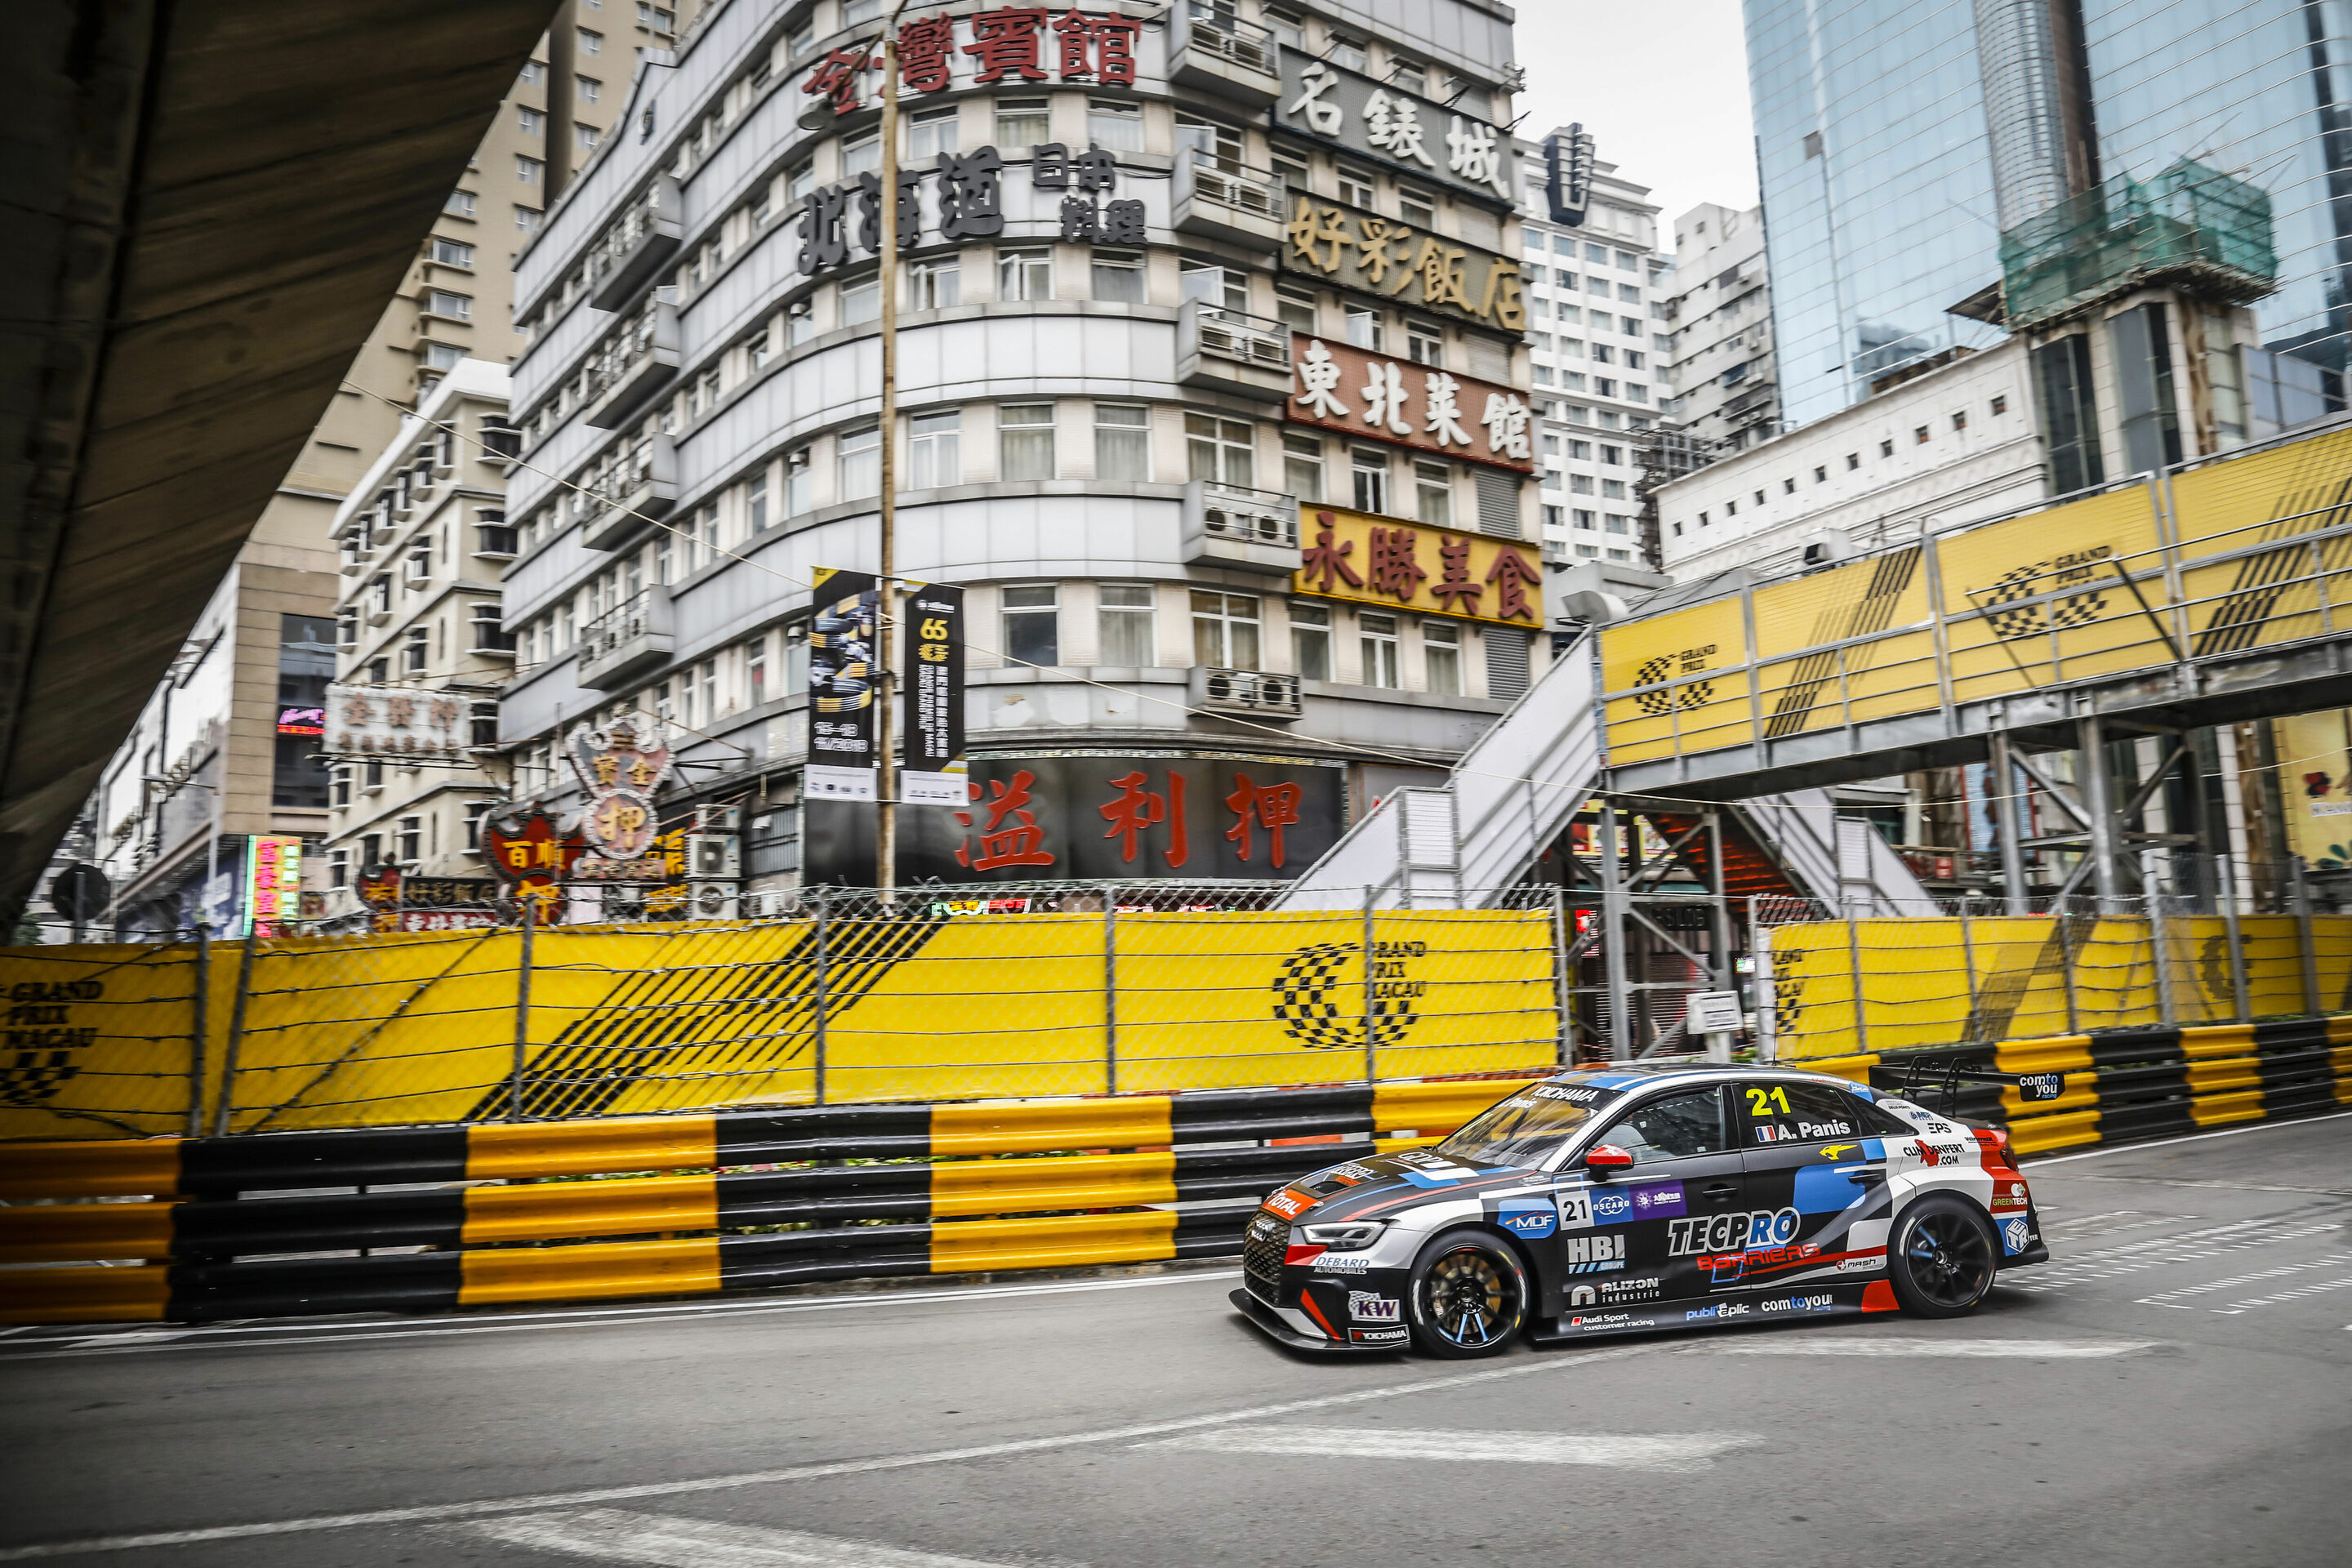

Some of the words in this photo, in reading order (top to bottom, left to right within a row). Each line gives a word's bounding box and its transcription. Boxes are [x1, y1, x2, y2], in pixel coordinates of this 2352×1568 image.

[1032, 142, 1116, 193] 日本
[1061, 194, 1147, 245] 料理
[1289, 197, 1527, 332] 好彩飯店
[1297, 340, 1532, 460] 東北菜館
[1303, 510, 1542, 619] 永勝美食
[920, 618, 948, 641] 65
[953, 769, 1303, 872] 溢利押
[1369, 941, 1427, 958] RAND
[1365, 961, 1406, 978] RIX
[1530, 1085, 1601, 1102] YOKOHAMA
[2036, 1084, 2058, 1098] you
[1745, 1086, 1792, 1117] 21
[1778, 1124, 1797, 1141] A.
[1798, 1119, 1851, 1138] Panis
[1927, 1122, 1952, 1134] EPS
[1268, 1191, 1302, 1215] TOTAL
[1593, 1200, 1630, 1211] OSCARO
[1993, 1197, 2028, 1206] GREENTECH
[1563, 1199, 1588, 1223] 21
[1517, 1214, 1555, 1229] MDF
[1668, 1206, 1802, 1257] TECPRO
[1567, 1234, 1626, 1263] HBI
[1316, 1256, 1370, 1267] DEBARD
[1602, 1290, 1660, 1303] industrie
[1358, 1300, 1397, 1316] KW
[1582, 1315, 1602, 1324] Audi
[1604, 1312, 1630, 1323] Sport
[1584, 1321, 1625, 1331] customer
[1627, 1319, 1655, 1327] racing
[1362, 1330, 1407, 1340] YOKOHAMA
